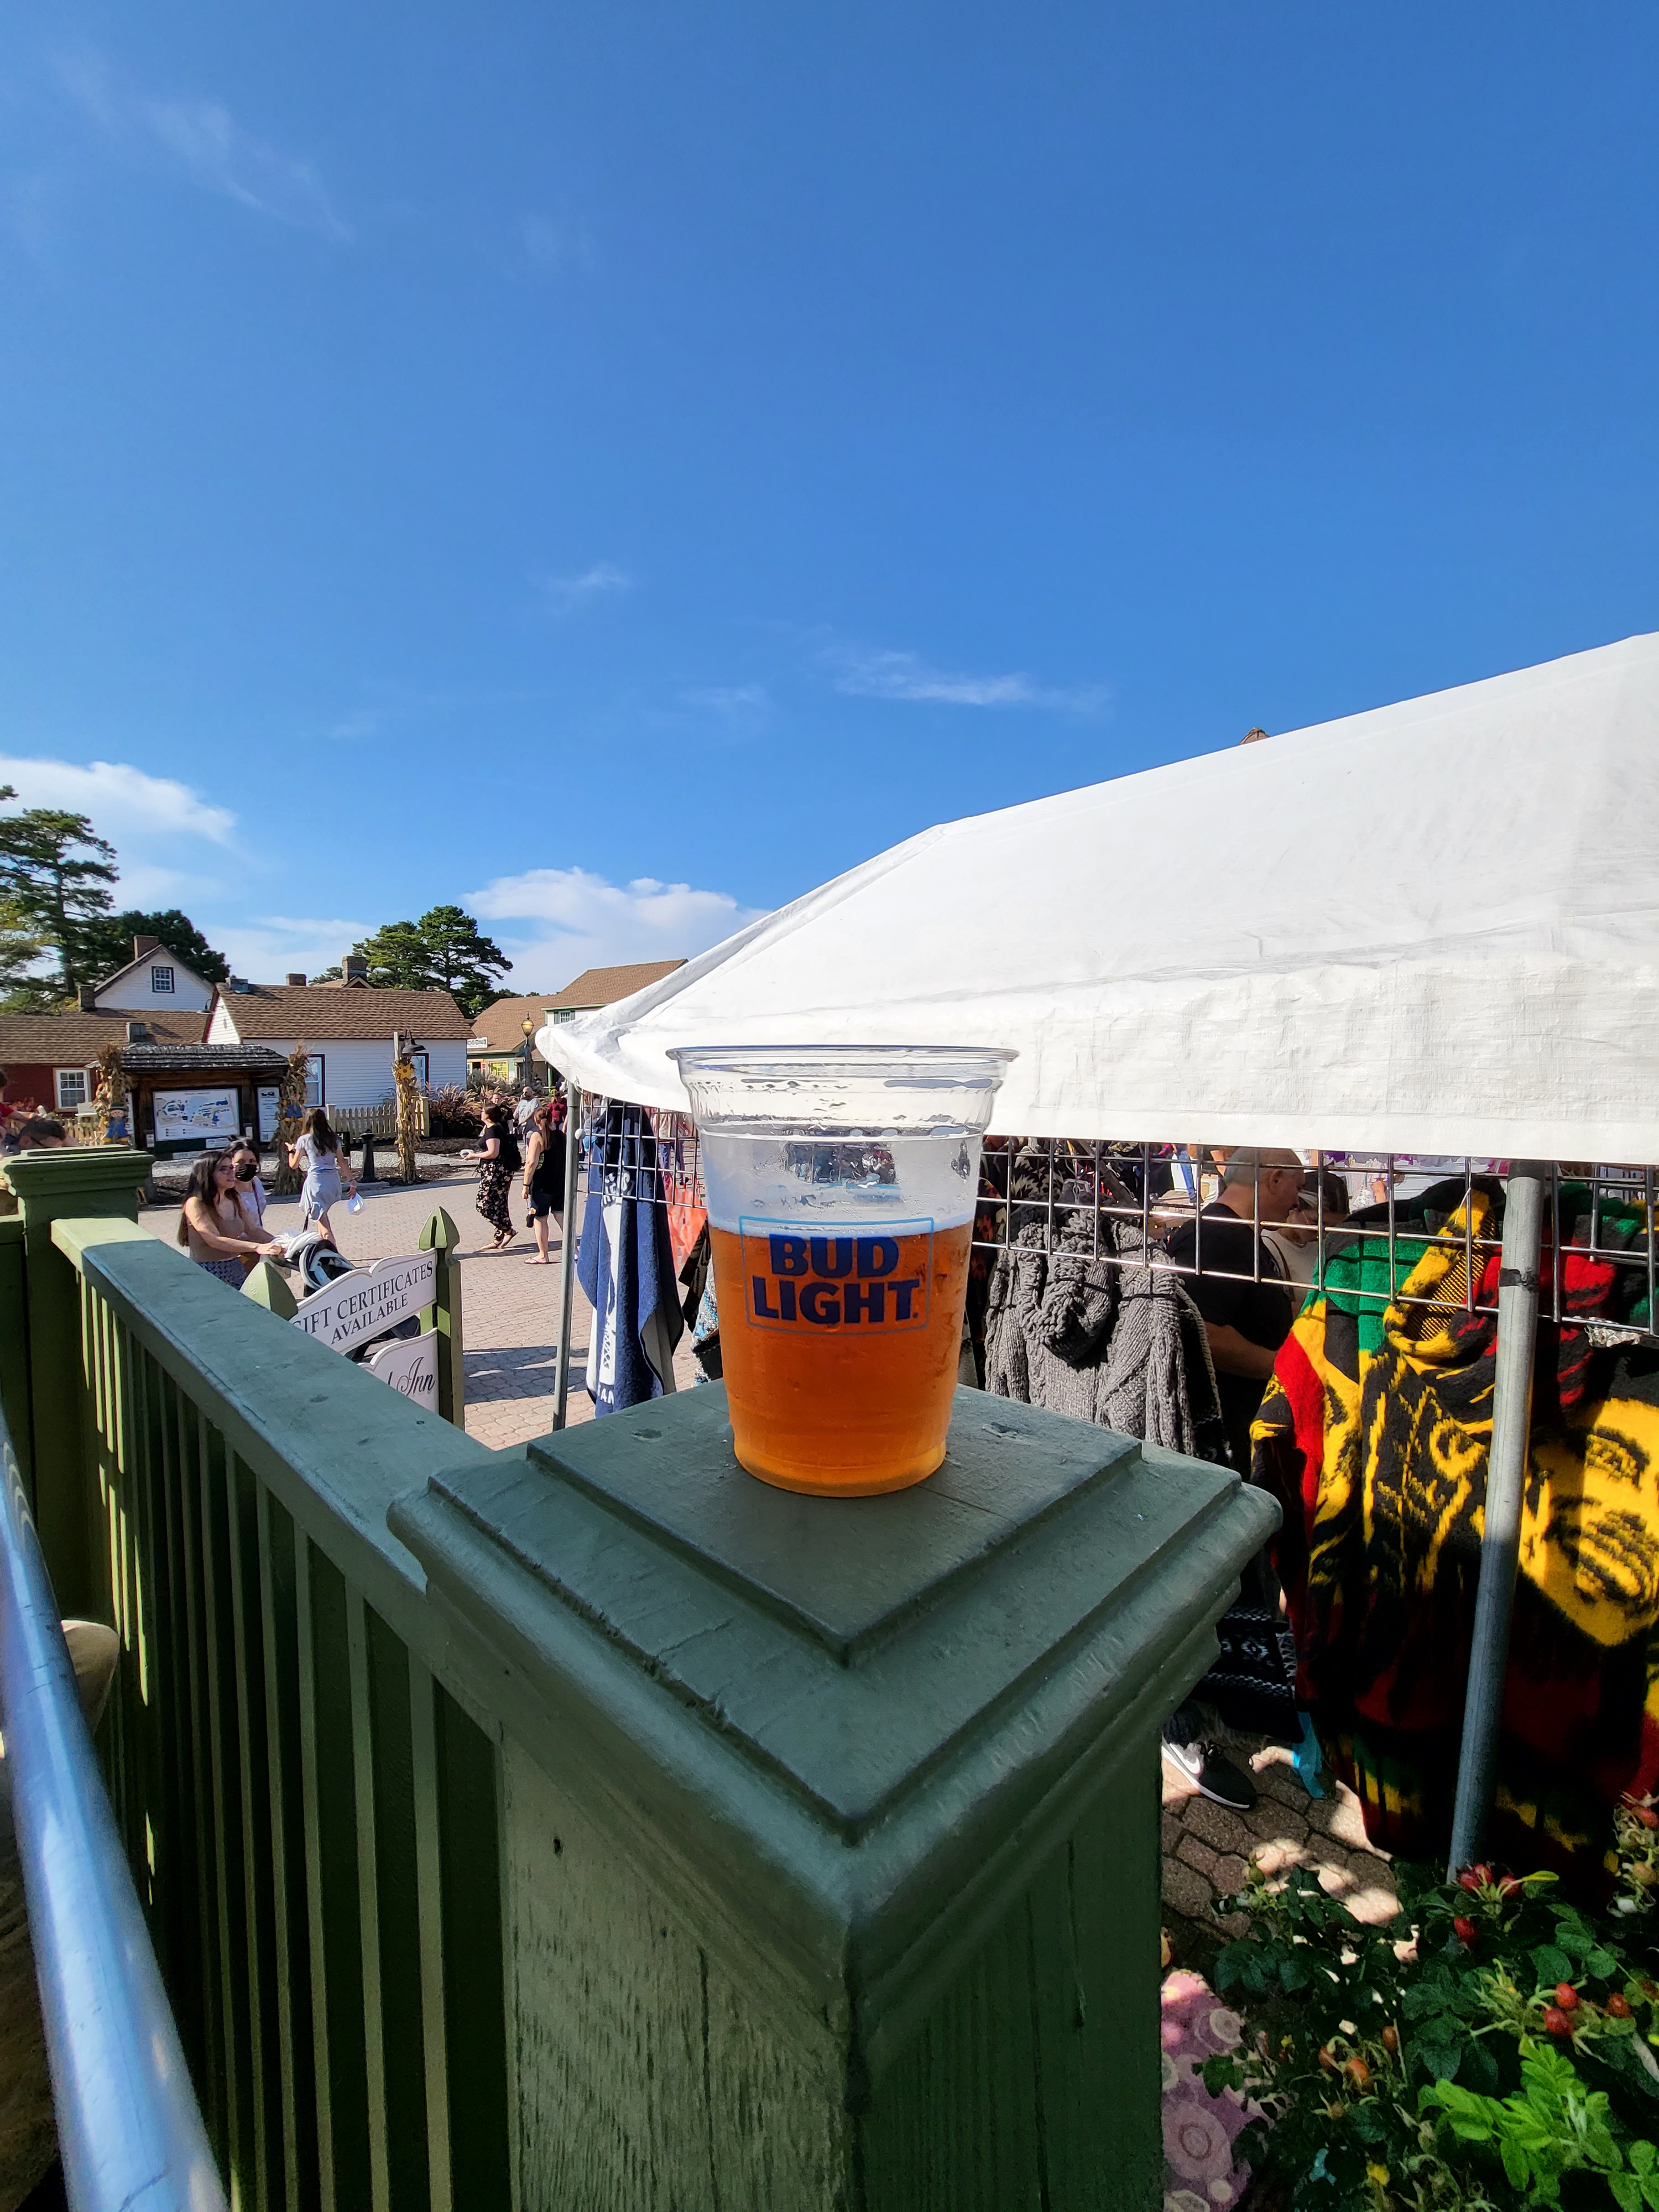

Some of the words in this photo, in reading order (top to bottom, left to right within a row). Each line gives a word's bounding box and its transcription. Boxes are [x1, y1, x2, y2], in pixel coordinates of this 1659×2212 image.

[769, 1234, 899, 1279] BUD
[337, 1261, 433, 1320] CERTIFICATES
[753, 1275, 920, 1324] LIGHT
[331, 1292, 408, 1345] AVAILABLE
[396, 1356, 436, 1396] Inn
